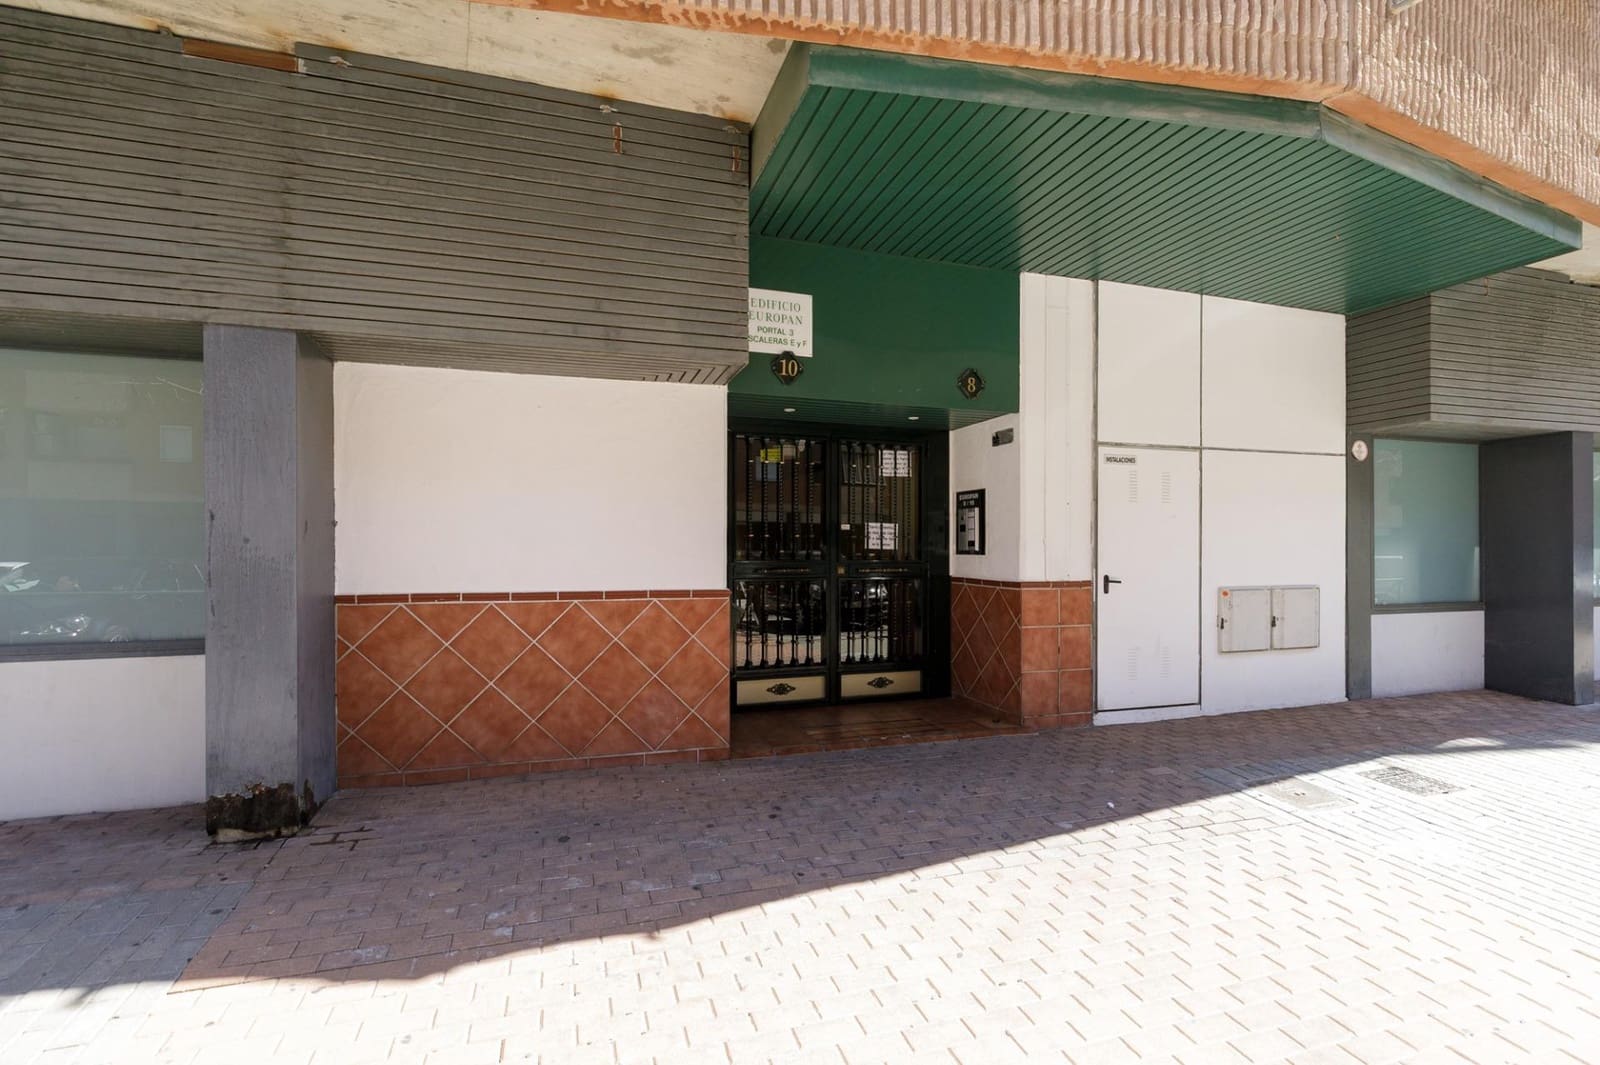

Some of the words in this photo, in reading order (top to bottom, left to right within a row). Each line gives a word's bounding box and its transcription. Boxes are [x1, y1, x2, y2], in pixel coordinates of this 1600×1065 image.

[751, 298, 801, 312] EDIFICIO
[748, 310, 803, 325] EUROPAN
[757, 325, 786, 336] PORTAL
[788, 328, 794, 336] 3
[748, 335, 788, 345] SCALERAS
[790, 338, 795, 347] E
[780, 359, 798, 377] 10
[967, 377, 976, 393] 8
